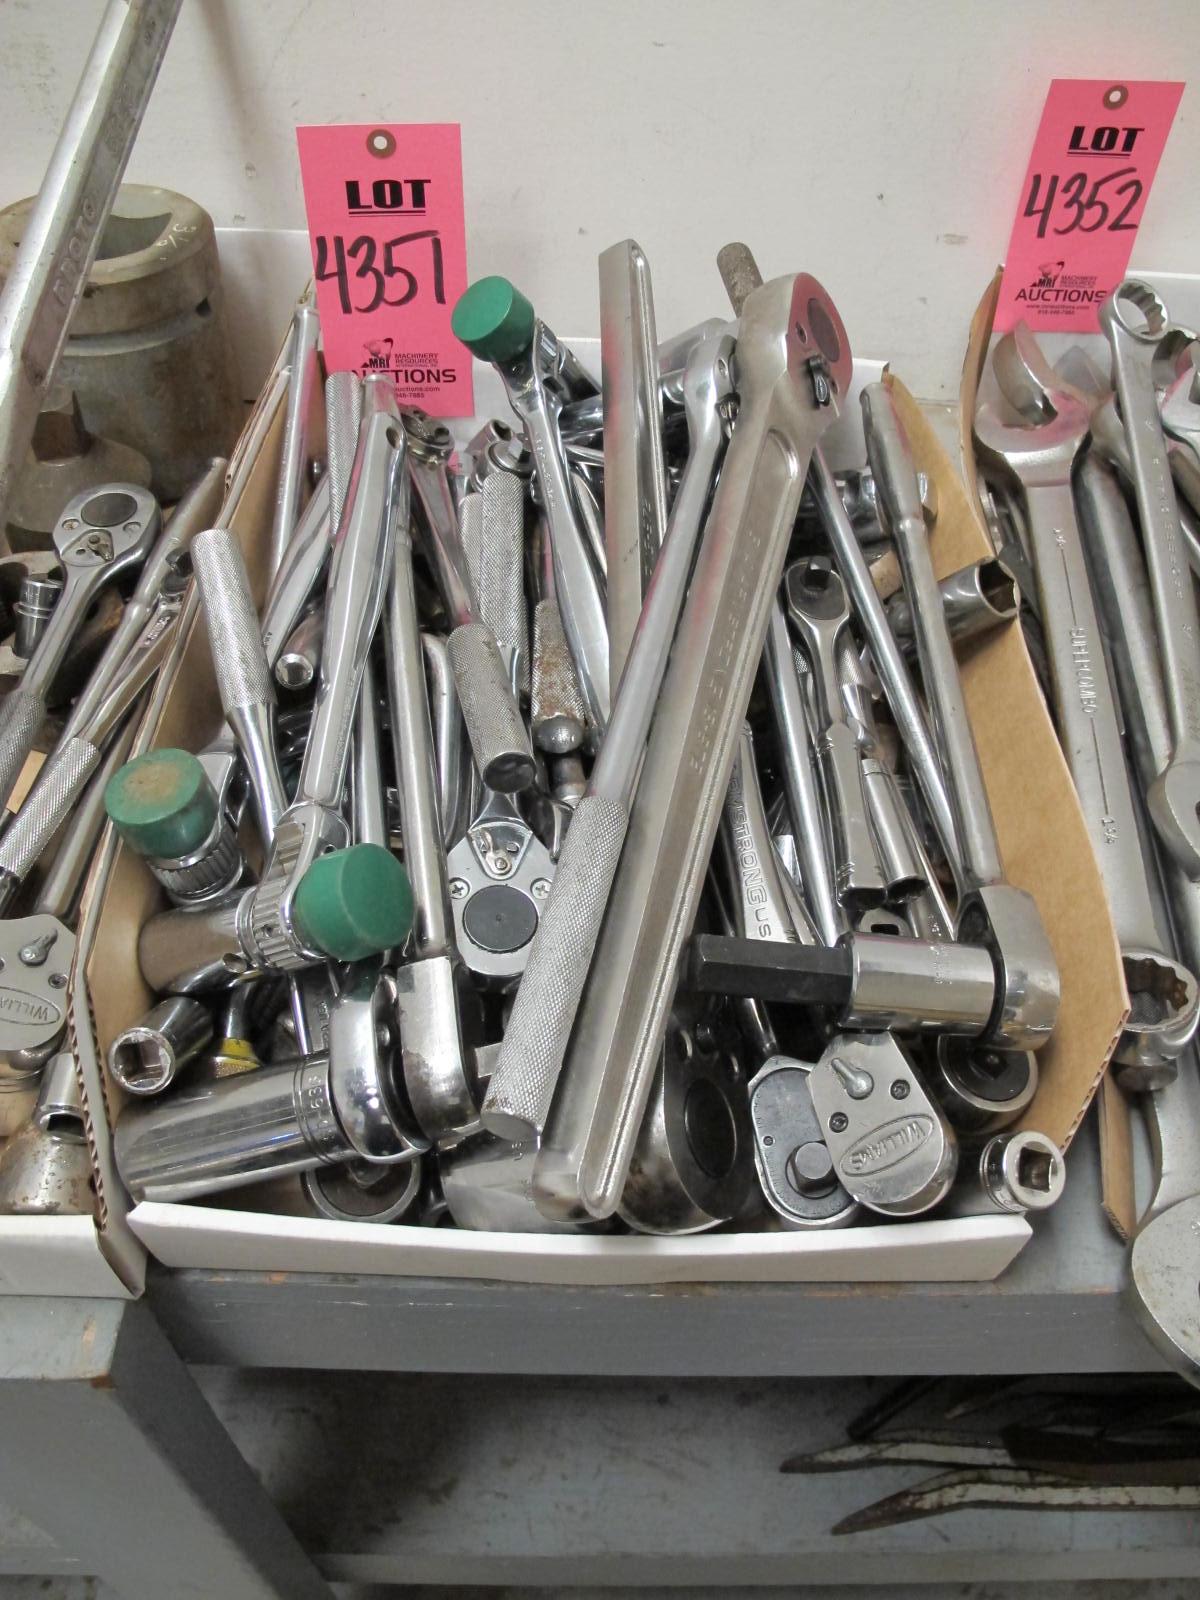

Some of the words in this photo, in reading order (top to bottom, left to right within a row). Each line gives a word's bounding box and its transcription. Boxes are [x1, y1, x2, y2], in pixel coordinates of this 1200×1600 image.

[1068, 125, 1145, 152] LOT
[345, 179, 431, 209] LOT
[1023, 166, 1143, 239] 4352
[315, 229, 446, 314] 4351
[1036, 278, 1058, 289] MRI
[1014, 288, 1107, 303] AUCTIONS
[368, 357, 391, 369] MRI
[394, 352, 440, 360] MACHINERY
[352, 368, 457, 384] TIONS
[0, 996, 49, 1022] WILLIA
[849, 1120, 927, 1171] WILLIAMS
